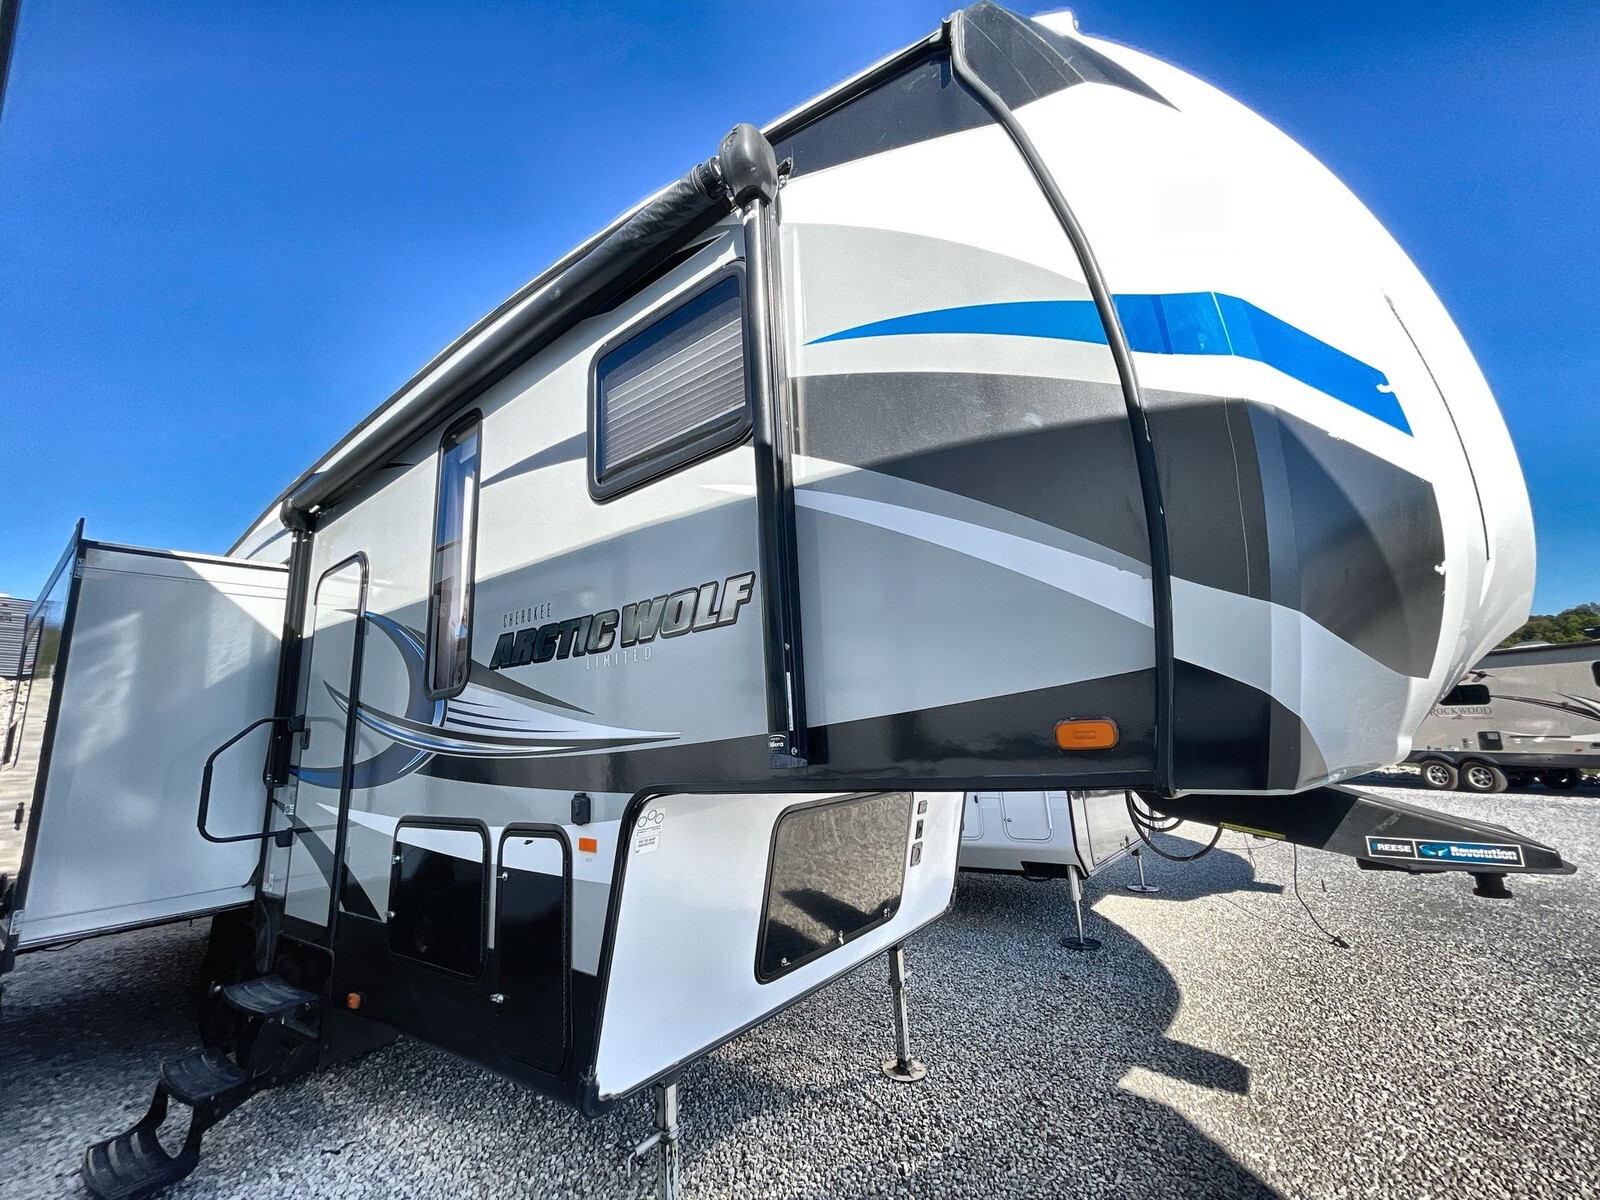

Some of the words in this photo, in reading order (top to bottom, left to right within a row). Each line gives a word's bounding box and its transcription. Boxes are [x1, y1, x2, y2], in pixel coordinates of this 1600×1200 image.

[489, 608, 620, 671] ARCTIC
[620, 570, 757, 649] WOLF
[503, 602, 551, 629] CHEROKEE
[586, 646, 653, 670] LIMITED
[1430, 707, 1492, 718] ROCKWOOD
[1377, 843, 1412, 852] REESE
[1449, 846, 1518, 860] Revolution
